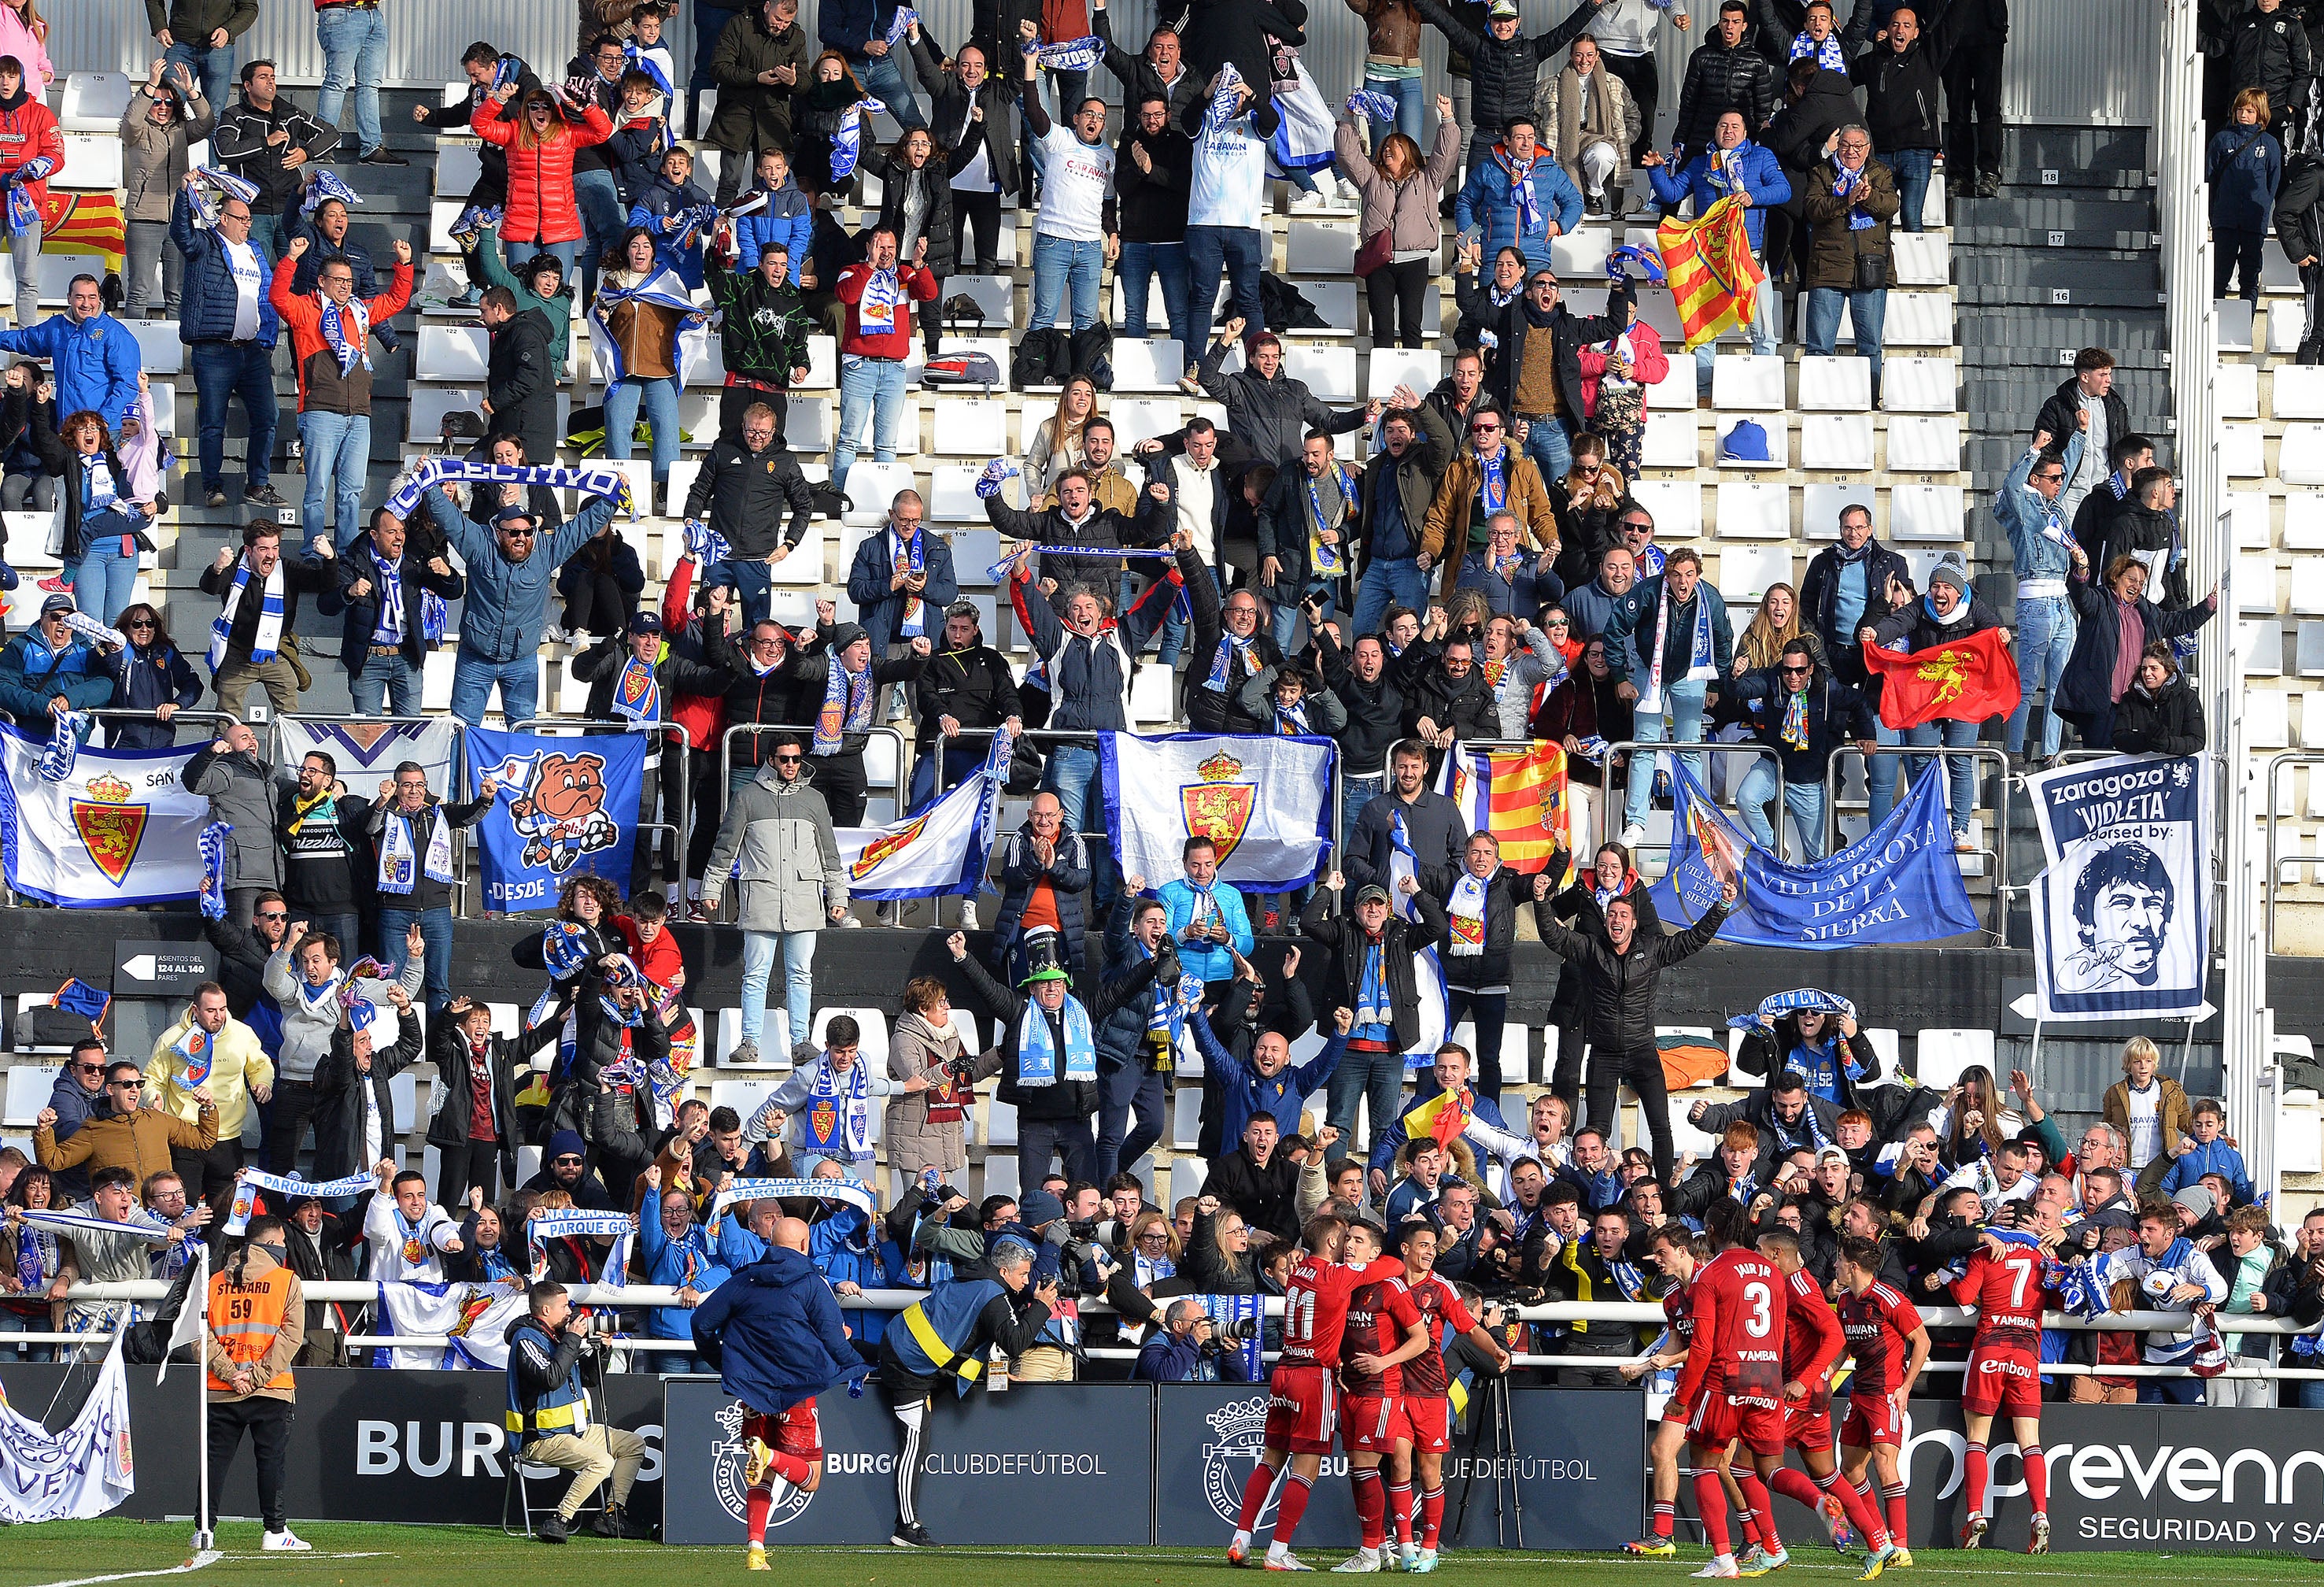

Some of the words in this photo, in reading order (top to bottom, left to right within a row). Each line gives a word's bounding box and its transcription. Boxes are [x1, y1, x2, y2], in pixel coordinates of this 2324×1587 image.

[1204, 142, 1247, 151] CARAVAN
[2055, 293, 2067, 301] 16
[2051, 767, 2164, 806] zaragoza
[292, 834, 345, 849] rizzlies
[2148, 826, 2174, 841] by:
[1811, 894, 1855, 919] DE
[1861, 875, 1898, 903] LA
[1801, 897, 1910, 942] SIERRA
[157, 964, 174, 974] 124
[175, 964, 187, 974] AL
[189, 964, 206, 973] 140
[264, 1175, 318, 1197] PARQUE
[323, 1185, 357, 1197] GOYA
[734, 1187, 796, 1200] PARQUE
[800, 1186, 841, 1198] GOYA
[550, 1222, 600, 1234] PARQUE
[604, 1221, 628, 1234] GO
[1734, 1263, 1757, 1279] JAIR
[1759, 1263, 1772, 1278] JR
[2004, 1260, 2031, 1308] 7
[231, 1299, 252, 1319] 59
[1285, 1286, 1316, 1341] 11
[1744, 1282, 1771, 1338] 3
[1999, 1315, 2037, 1330] AMBAR
[1979, 1359, 2032, 1379] embou
[2078, 1517, 2256, 1543] SEGURIDAD
[2266, 1522, 2285, 1543] Y
